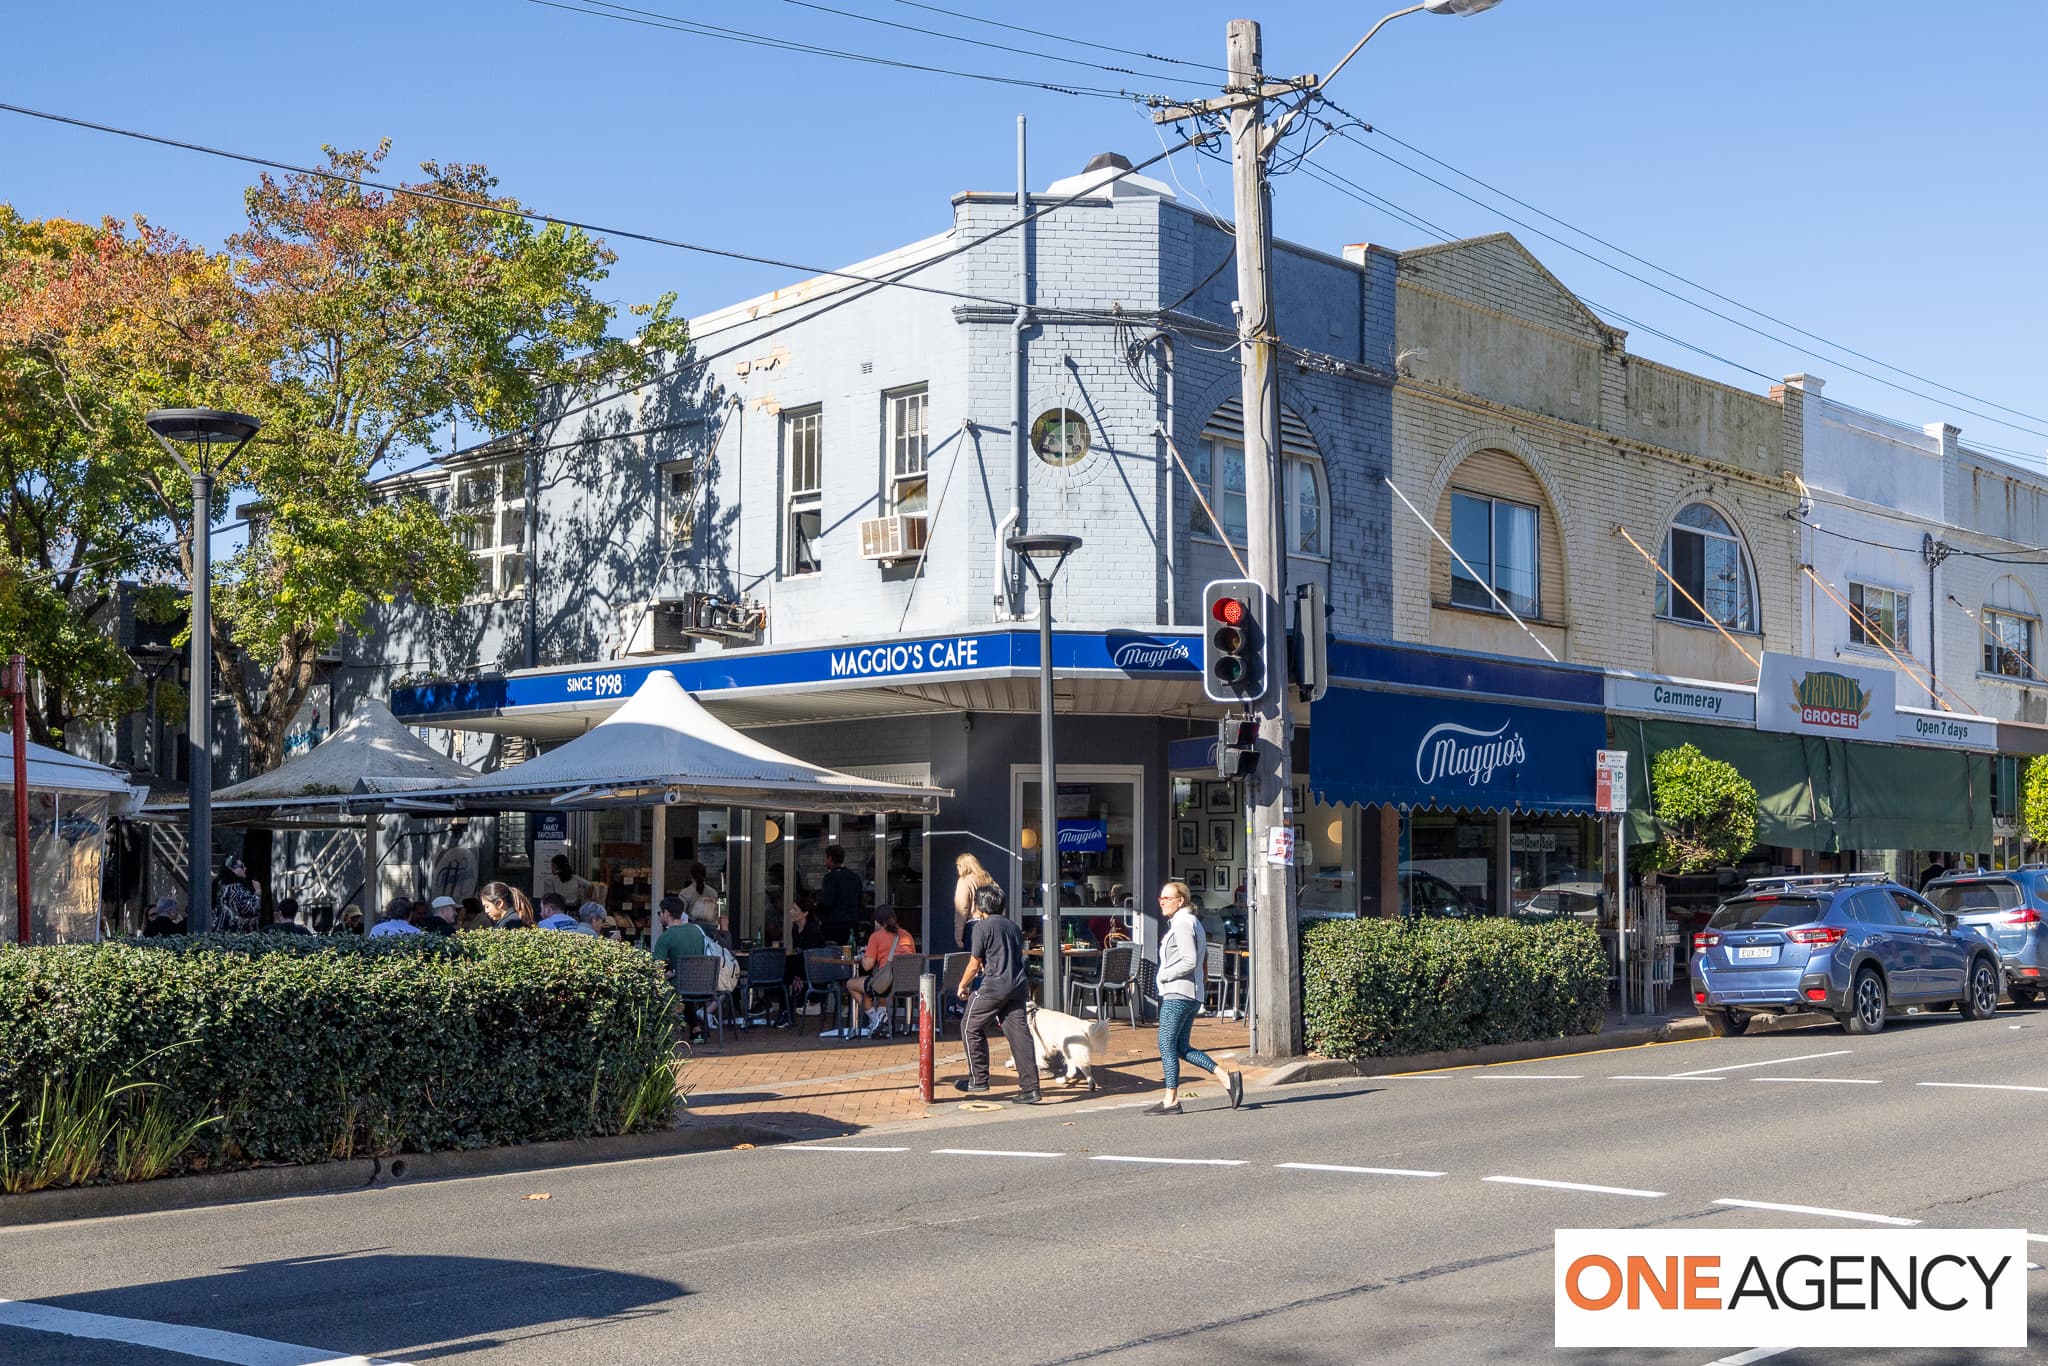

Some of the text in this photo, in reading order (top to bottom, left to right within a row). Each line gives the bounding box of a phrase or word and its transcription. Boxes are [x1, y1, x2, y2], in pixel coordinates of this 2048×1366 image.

[831, 638, 978, 677] MAGGIO'S CAFE
[1114, 640, 1189, 668] Maggio's
[567, 674, 622, 696] SINCE 1998
[1805, 672, 1859, 711] FRIENDLY
[1654, 686, 1722, 714] Cammeray
[1803, 708, 1858, 727] GROCER
[1916, 718, 1968, 740] Open 7 days
[1416, 717, 1526, 787] Maggio's
[1614, 771, 1624, 782] 1P
[543, 823, 559, 832] FAMILY
[1057, 826, 1103, 845] Maggio's
[1526, 835, 1540, 849] Down
